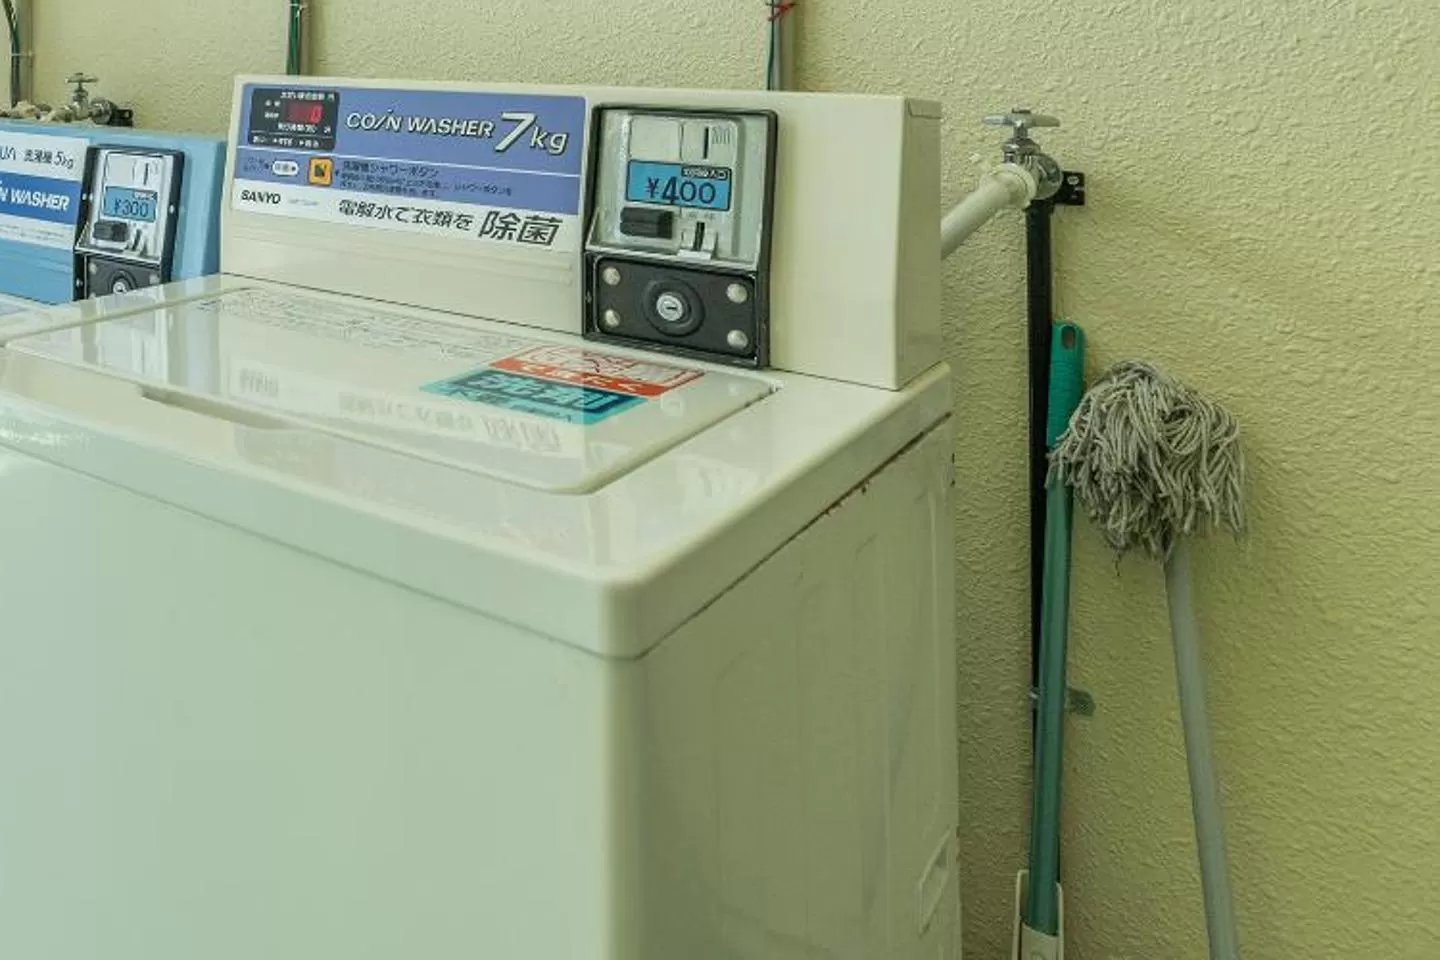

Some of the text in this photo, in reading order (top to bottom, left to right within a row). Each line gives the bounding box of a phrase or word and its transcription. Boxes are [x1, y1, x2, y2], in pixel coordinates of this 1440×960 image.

[346, 109, 401, 132] COIN
[408, 117, 495, 138] WASHER
[10, 190, 70, 212] WASHER
[645, 176, 717, 205] ¥400
